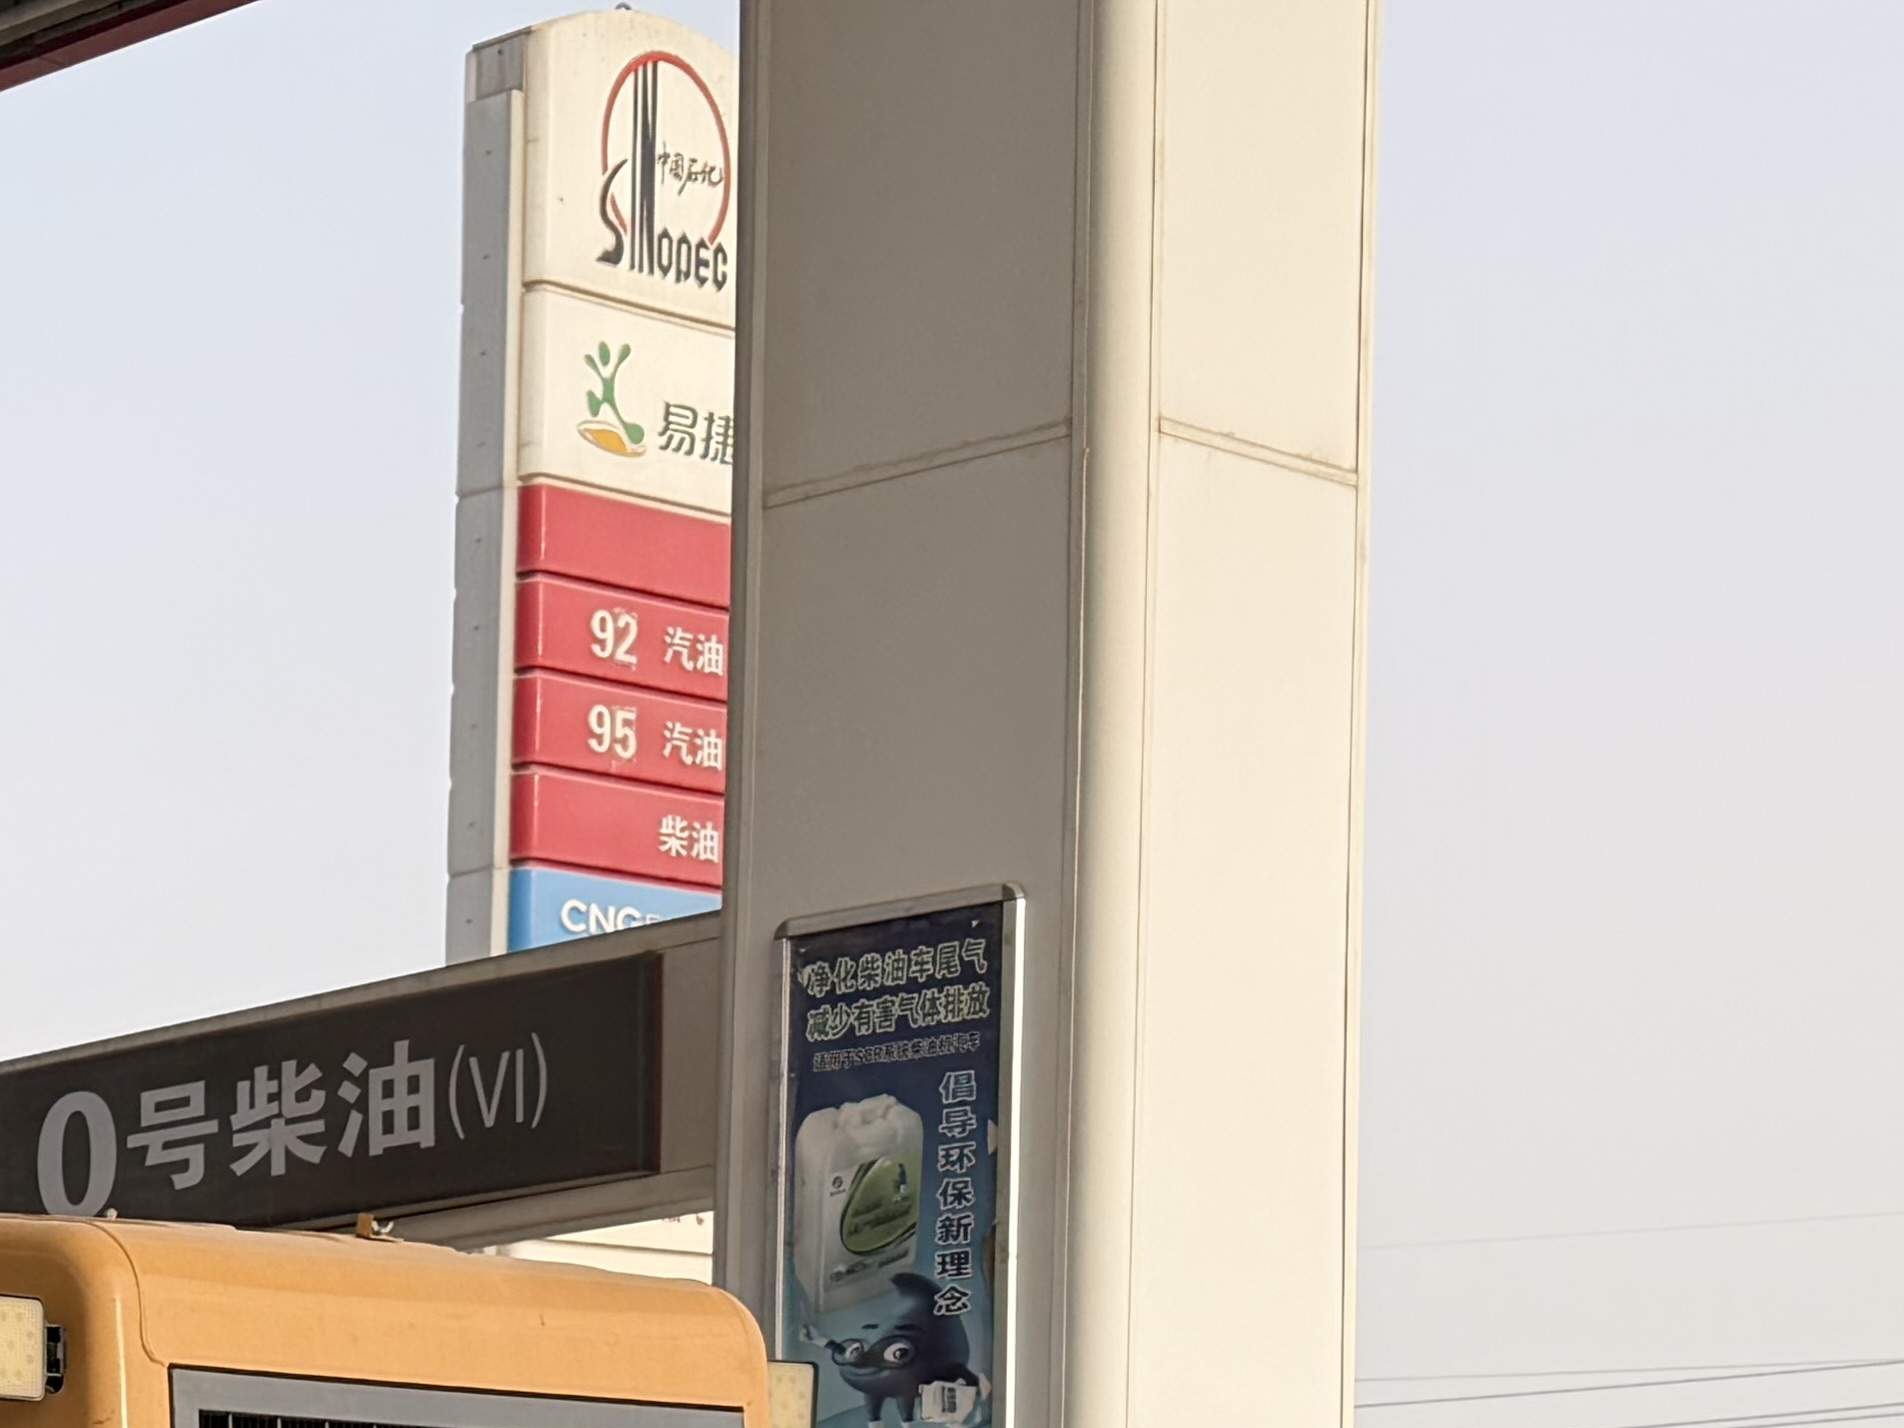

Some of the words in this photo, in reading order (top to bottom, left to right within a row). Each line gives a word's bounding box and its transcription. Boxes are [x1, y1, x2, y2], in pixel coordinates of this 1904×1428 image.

[595, 60, 728, 293] SINOPEC
[656, 141, 725, 196] 中国石化
[658, 400, 734, 465] 易捷
[590, 608, 638, 666] 92
[663, 627, 724, 677] 汽油
[587, 704, 637, 761] 95
[663, 720, 723, 771] 汽油
[658, 814, 720, 864] 柴油
[806, 938, 988, 998] 净化柴油车尾气
[805, 981, 990, 1043] 减少有害气体排放
[932, 1069, 977, 1317] 倡导环保新理念
